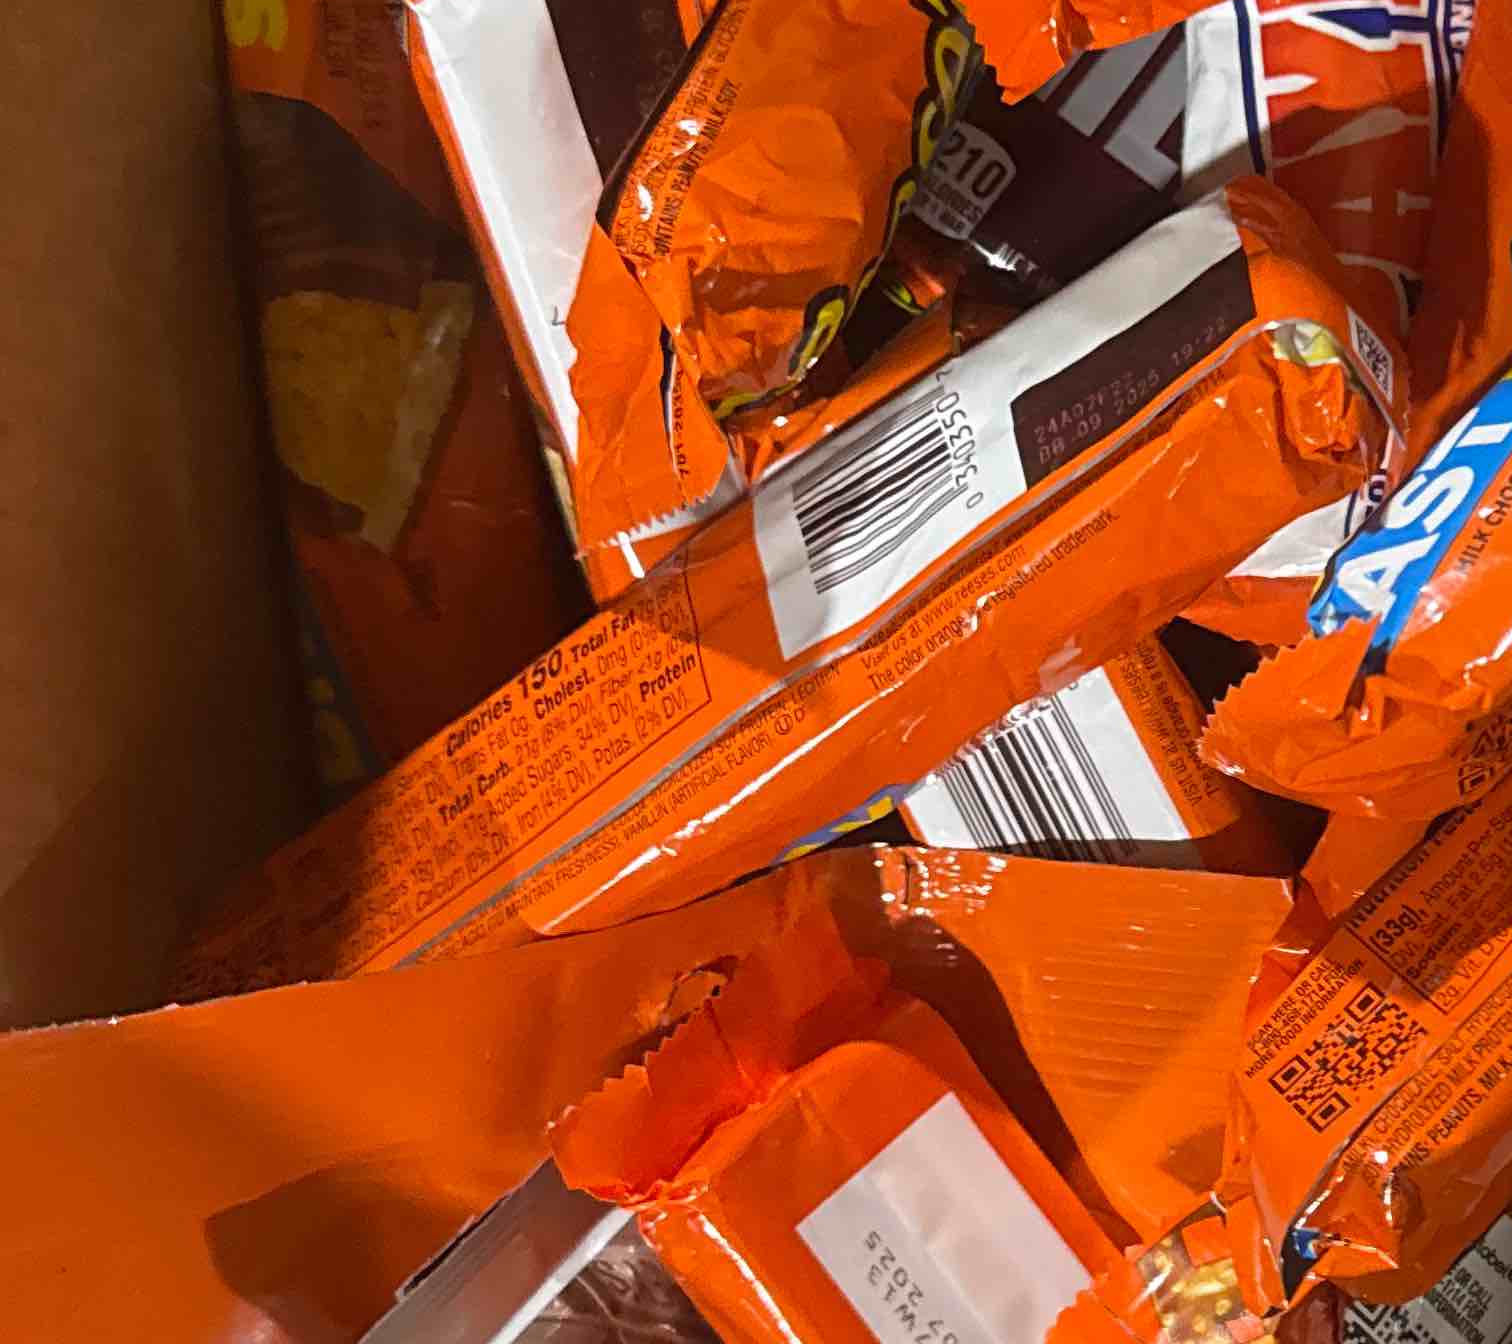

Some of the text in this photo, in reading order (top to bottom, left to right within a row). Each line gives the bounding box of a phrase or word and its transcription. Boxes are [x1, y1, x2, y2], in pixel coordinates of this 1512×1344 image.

[1453, 524, 1495, 576] MILK
[866, 664, 894, 690] The
[891, 643, 926, 674] color
[1050, 504, 1121, 561] trademark.
[440, 608, 637, 756] Calories Total Fat
[638, 651, 697, 702] Protein
[1246, 1023, 1302, 1078] MORE FOOD
[1424, 1079, 1487, 1148] PEANUTS,
